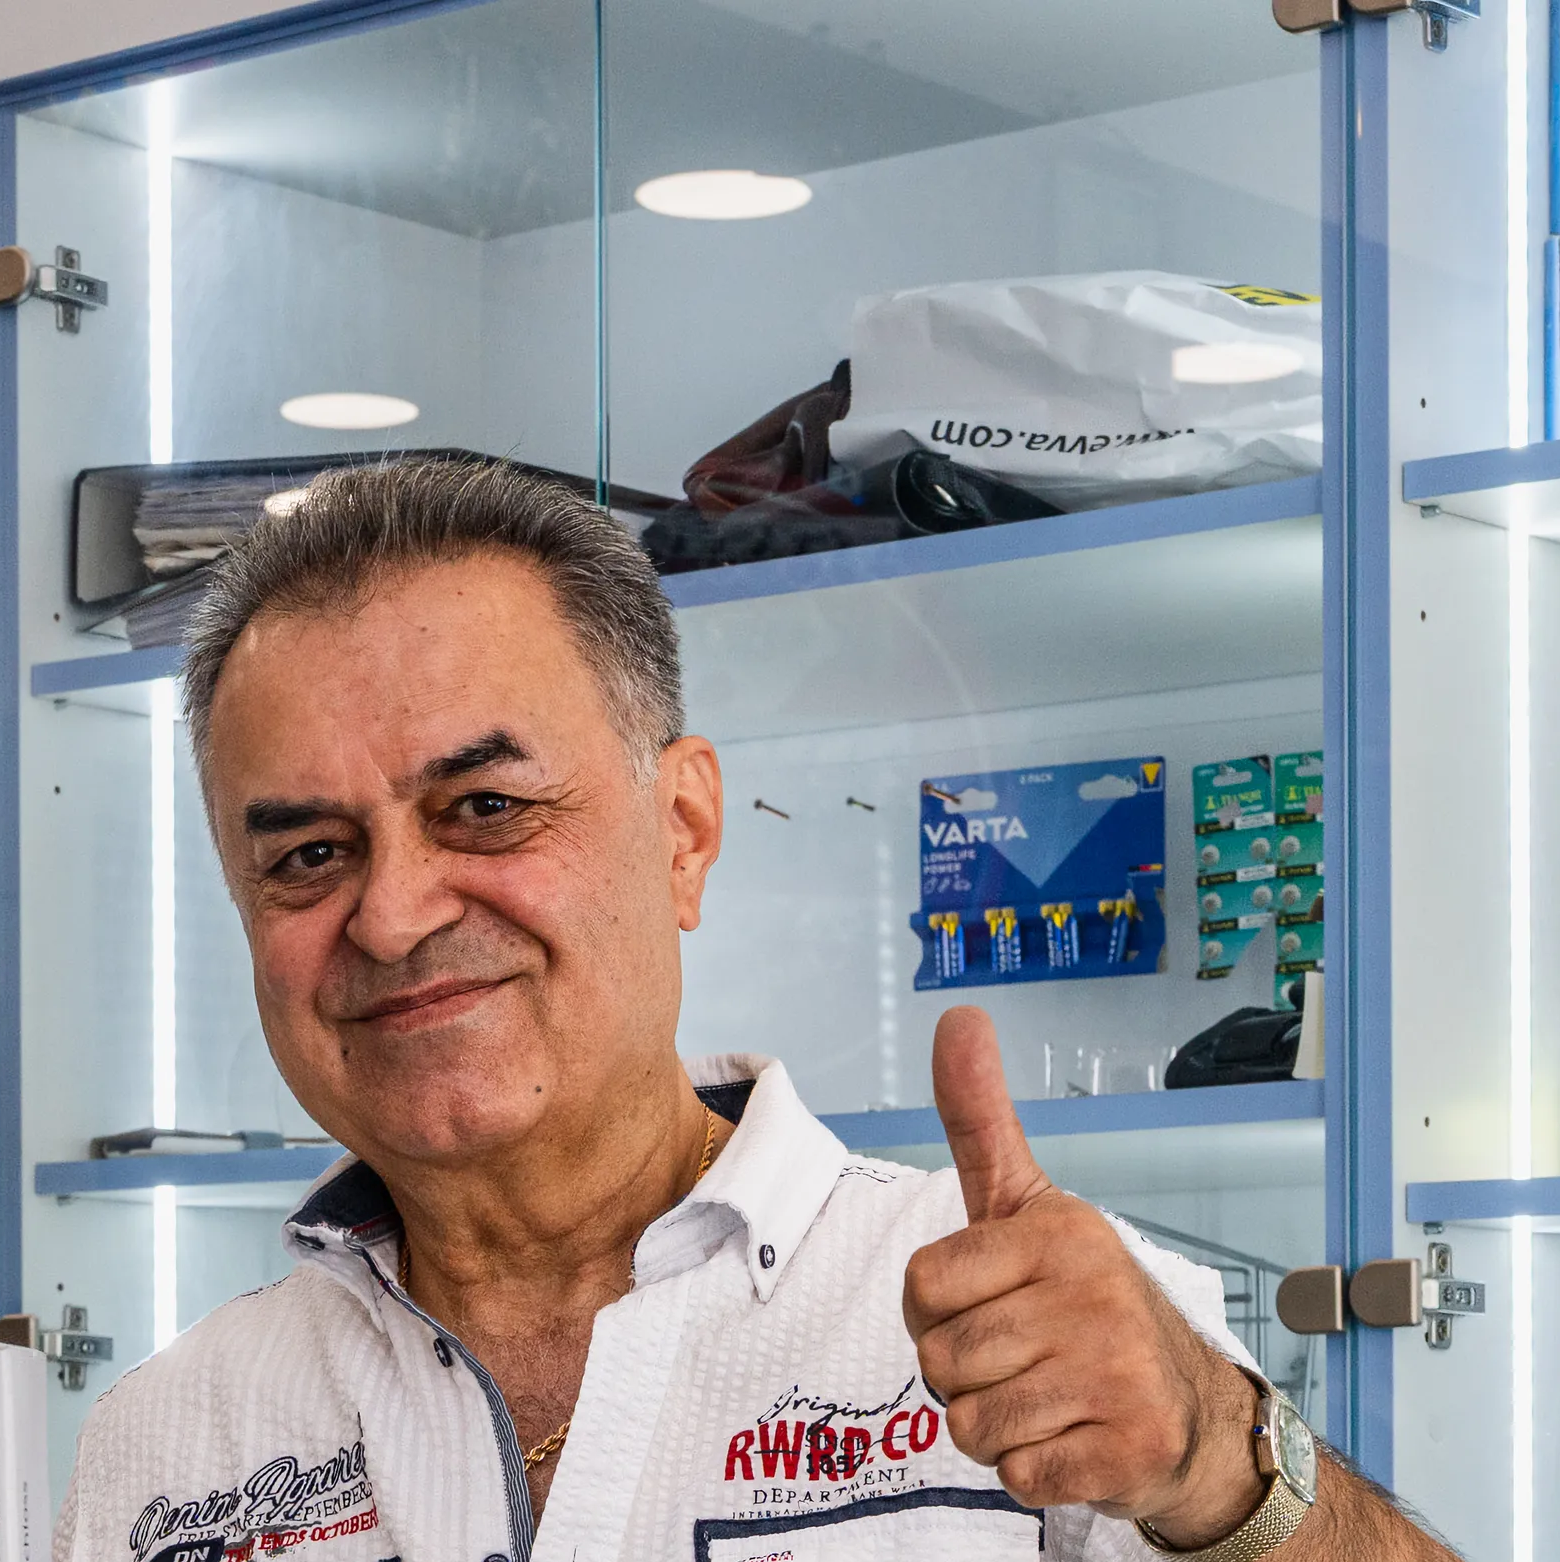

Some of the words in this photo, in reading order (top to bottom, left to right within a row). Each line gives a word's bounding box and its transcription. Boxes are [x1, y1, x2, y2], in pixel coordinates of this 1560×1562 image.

[923, 815, 1029, 849] VARTA
[922, 861, 962, 875] POWER
[257, 1530, 307, 1551] ENDS
